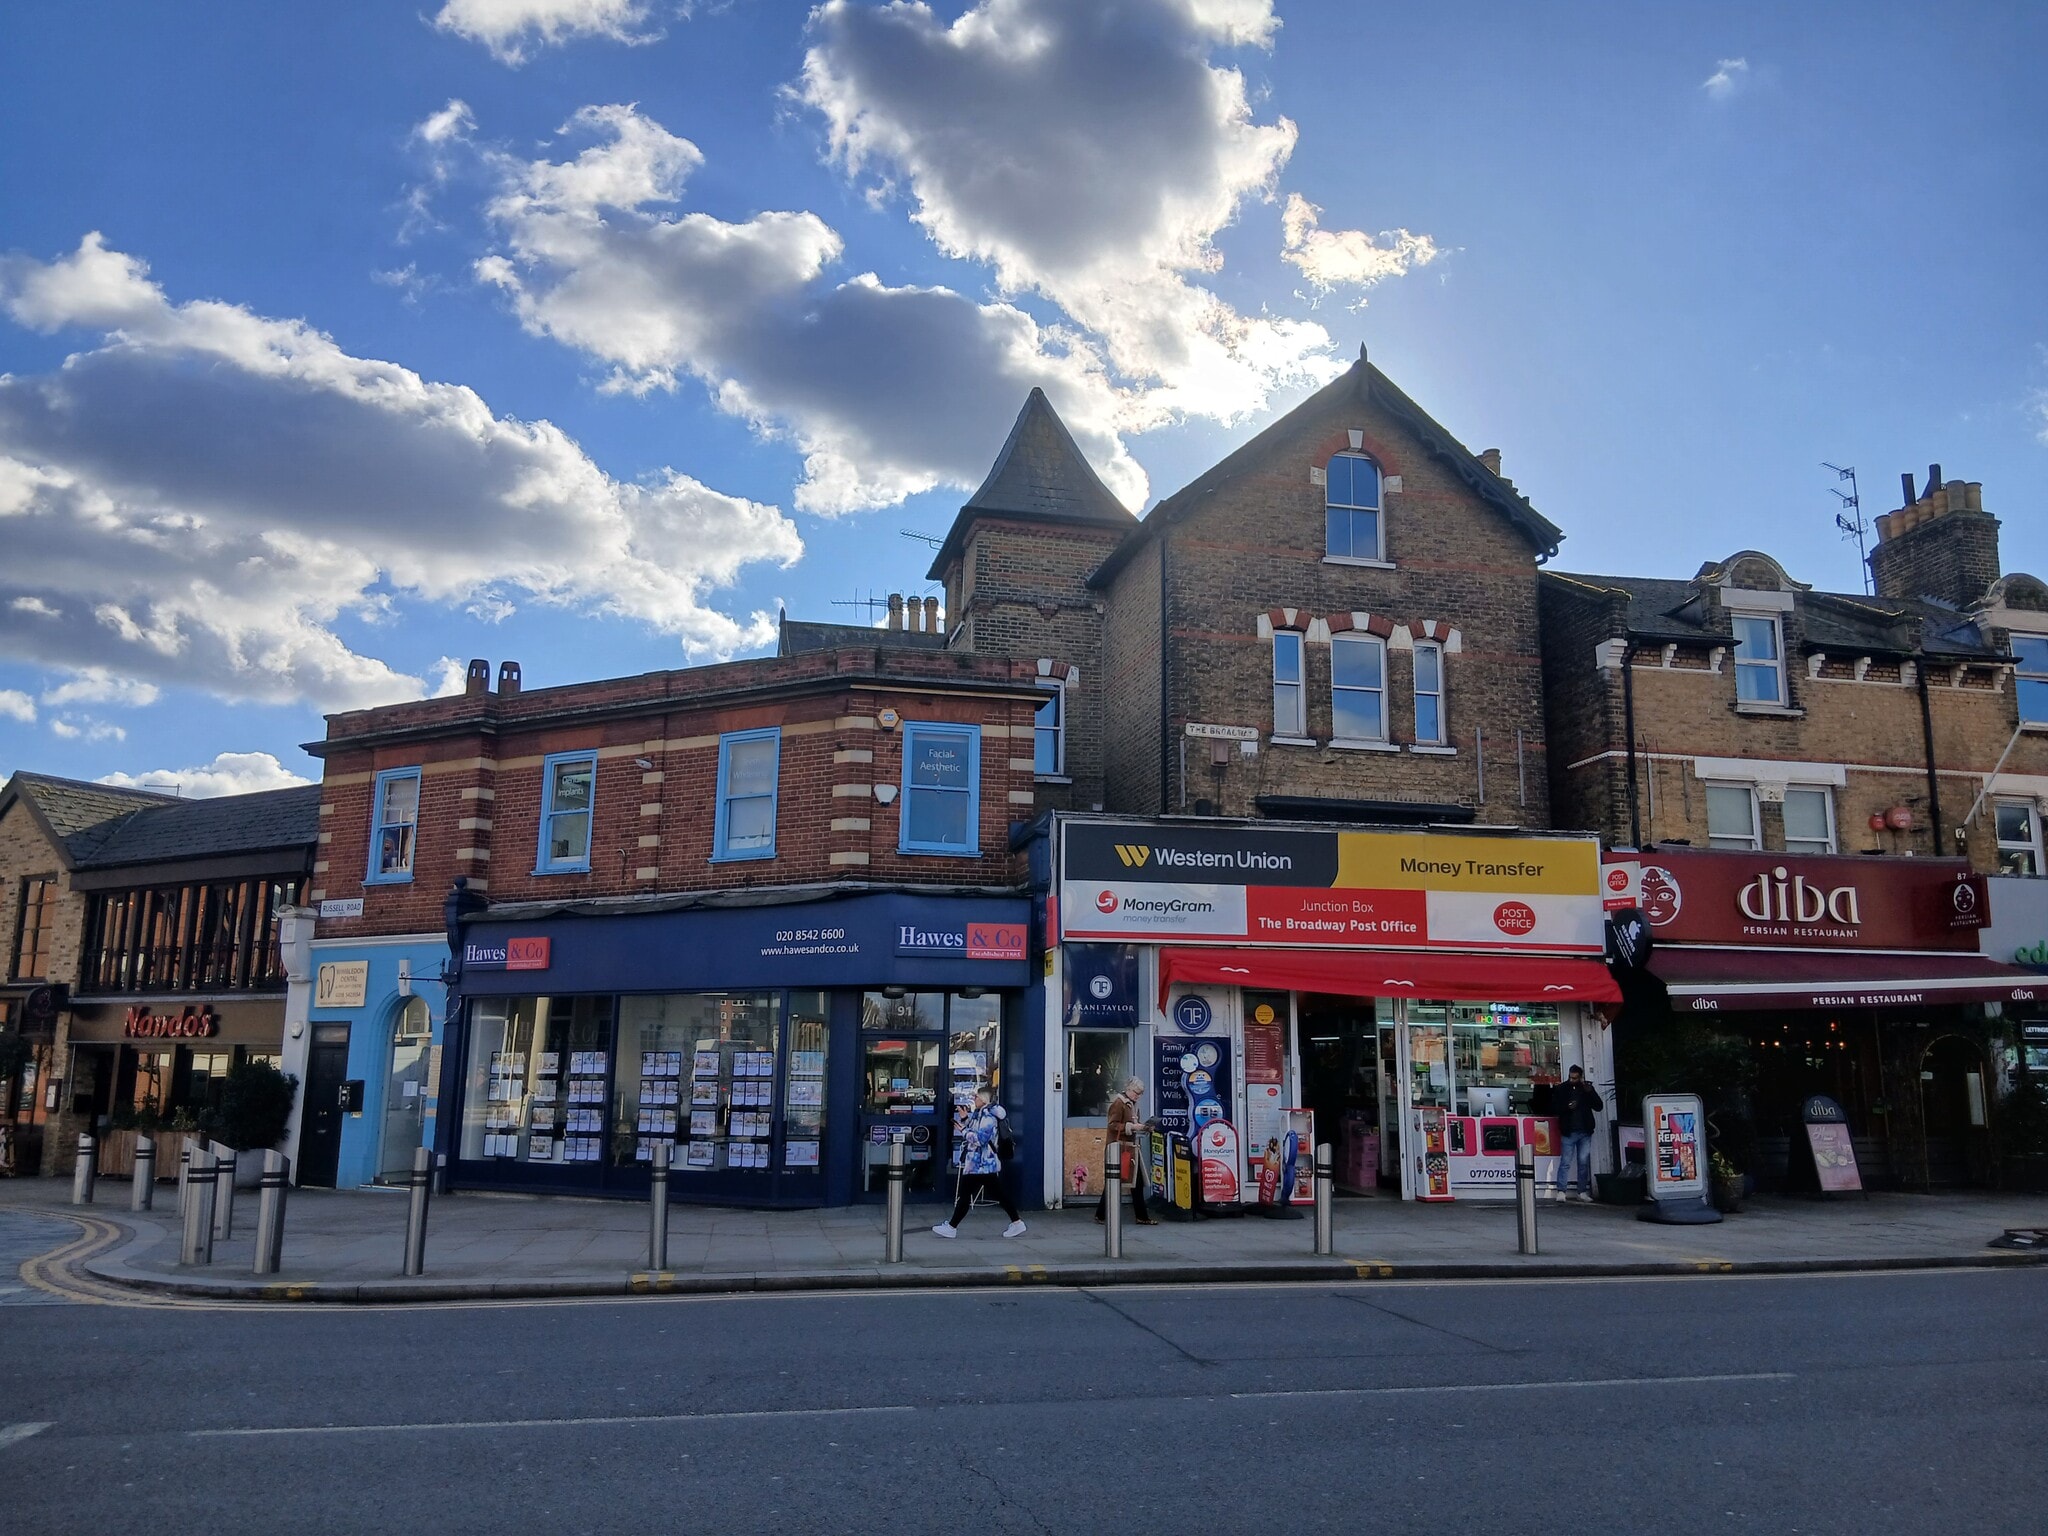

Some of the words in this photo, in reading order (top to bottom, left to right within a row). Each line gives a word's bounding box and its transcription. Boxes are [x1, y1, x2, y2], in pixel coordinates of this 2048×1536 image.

[1189, 724, 1207, 734] THE
[928, 748, 954, 759] Facial
[919, 761, 961, 772] Aesthetic
[558, 787, 585, 799] Implants
[1154, 847, 1234, 868] Western
[1237, 850, 1293, 870] Union
[1400, 857, 1461, 877] Money
[1465, 860, 1545, 877] Transfer
[1956, 872, 1967, 881] 87
[1609, 879, 1627, 887] OFFICE
[1737, 865, 1862, 925] diba
[323, 904, 345, 913] RUSSELL
[346, 902, 362, 912] ROAD
[1300, 899, 1349, 913] Junction
[1352, 900, 1374, 913] Box
[1501, 908, 1528, 918] POST
[1122, 915, 1153, 924] money
[1153, 914, 1187, 925] transfer
[1497, 917, 1533, 929] OFFICE
[1950, 918, 1983, 927] RESTAURANT
[1258, 917, 1282, 930] The
[1286, 918, 1346, 934] Broadway
[1350, 919, 1377, 932] Post
[1380, 920, 1417, 933] Office
[776, 929, 794, 941] 020
[795, 928, 819, 941] 8542
[821, 927, 845, 940] 6600
[899, 925, 965, 948] Hawes
[972, 928, 989, 947] &
[995, 929, 1023, 948] Co
[1743, 925, 1788, 936] PERSIAN
[1793, 927, 1859, 938] RESTAURANT
[1620, 923, 1636, 953] REPAIRS
[466, 944, 507, 961] Hawes
[510, 942, 521, 959] &
[526, 942, 543, 959] Co
[760, 942, 861, 957] www.hawesandco.co.uk
[336, 967, 365, 975] LEDON
[1812, 995, 1855, 1006] PERSIAN
[1859, 993, 1924, 1005] RESTAURANT
[2011, 988, 2035, 1000] diba
[1067, 1003, 1100, 1012] FARANI
[1101, 1004, 1135, 1013] TAYLOR
[1497, 1003, 1521, 1013] iPhone
[1691, 997, 1719, 1011] diba
[897, 1006, 913, 1017] 91
[125, 1004, 212, 1038] Nando's
[1476, 1015, 1502, 1024] HOE
[1162, 1055, 1181, 1063] Imm
[1162, 1066, 1182, 1075] Conv
[1162, 1079, 1182, 1089] Litig
[1162, 1091, 1182, 1099] Wills
[1810, 1100, 1837, 1117] diba
[1162, 1117, 1179, 1127] 020
[1657, 1132, 1695, 1144] REPAIRS
[1203, 1147, 1235, 1155] MoneyGram
[1470, 1169, 1518, 1178] 07707850
